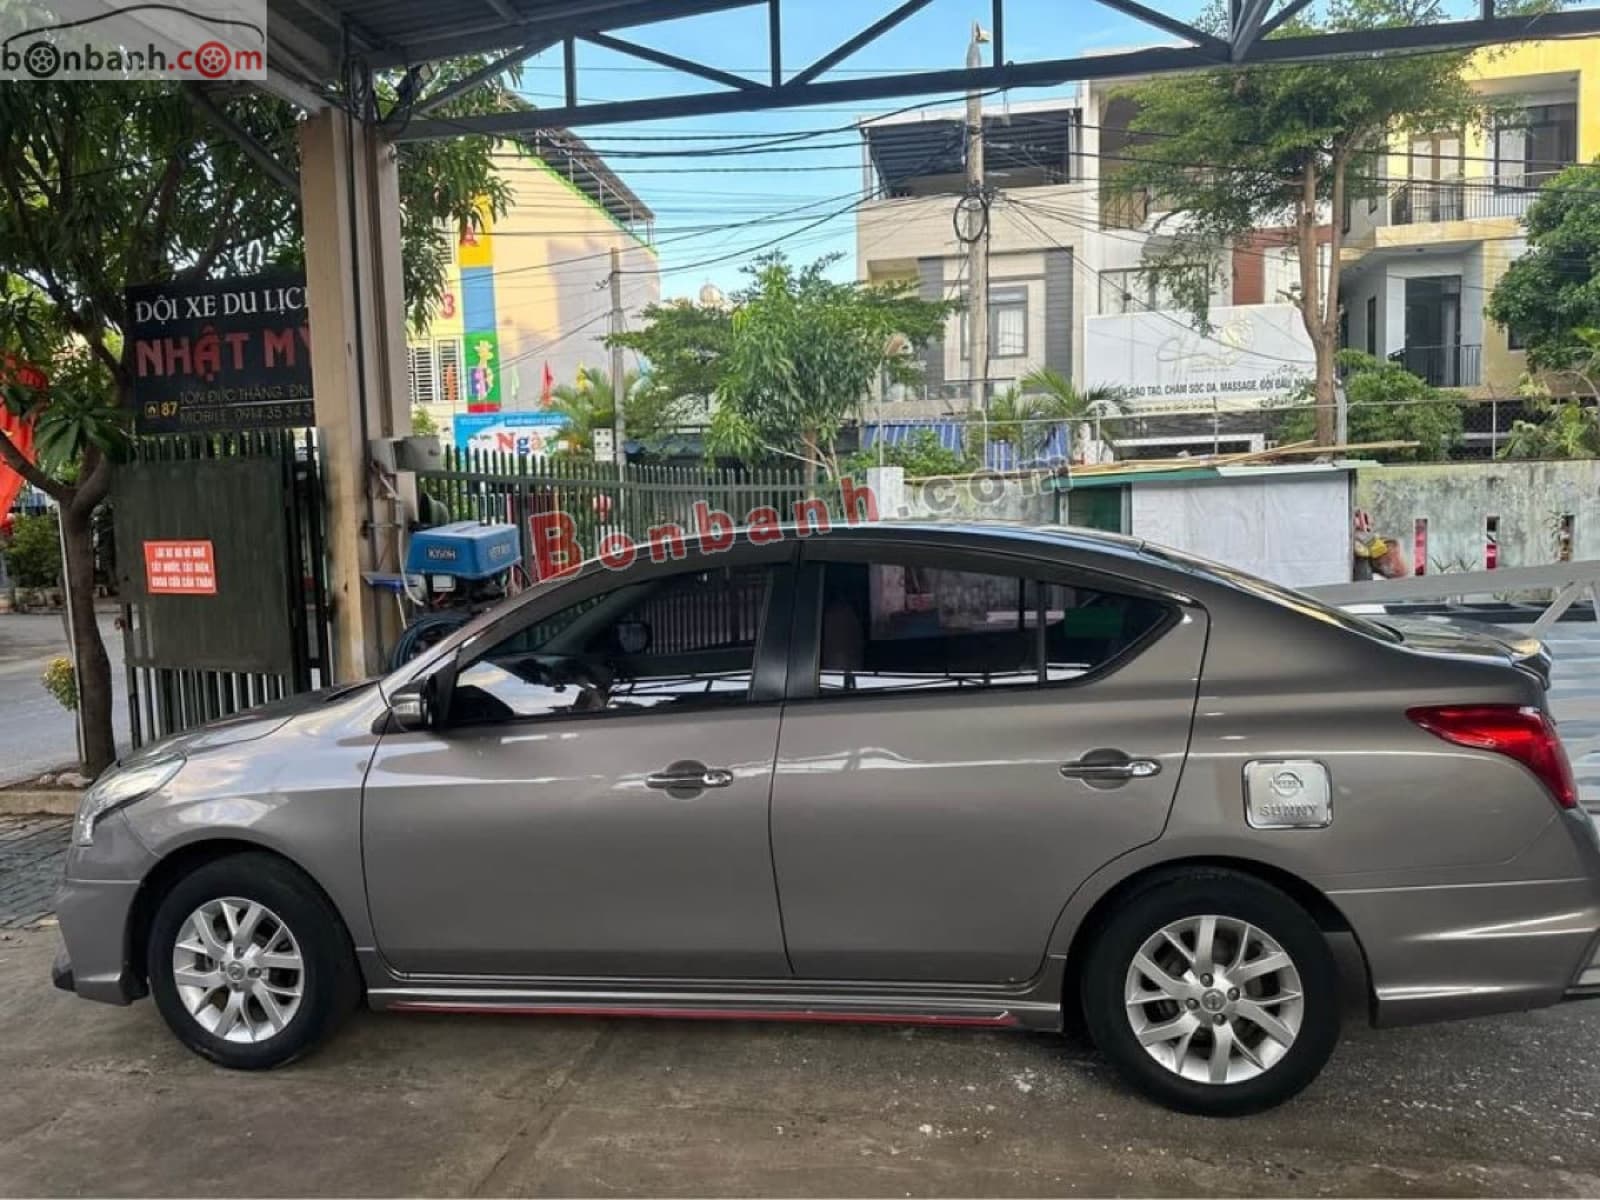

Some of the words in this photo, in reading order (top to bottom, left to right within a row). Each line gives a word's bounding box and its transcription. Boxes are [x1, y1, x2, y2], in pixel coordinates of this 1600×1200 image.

[135, 294, 178, 325] ĐỘI
[185, 295, 217, 319] XE
[222, 291, 259, 315] DU
[135, 325, 249, 382] NHẬT
[160, 400, 178, 417] 87
[1260, 804, 1318, 817] SUNNY
